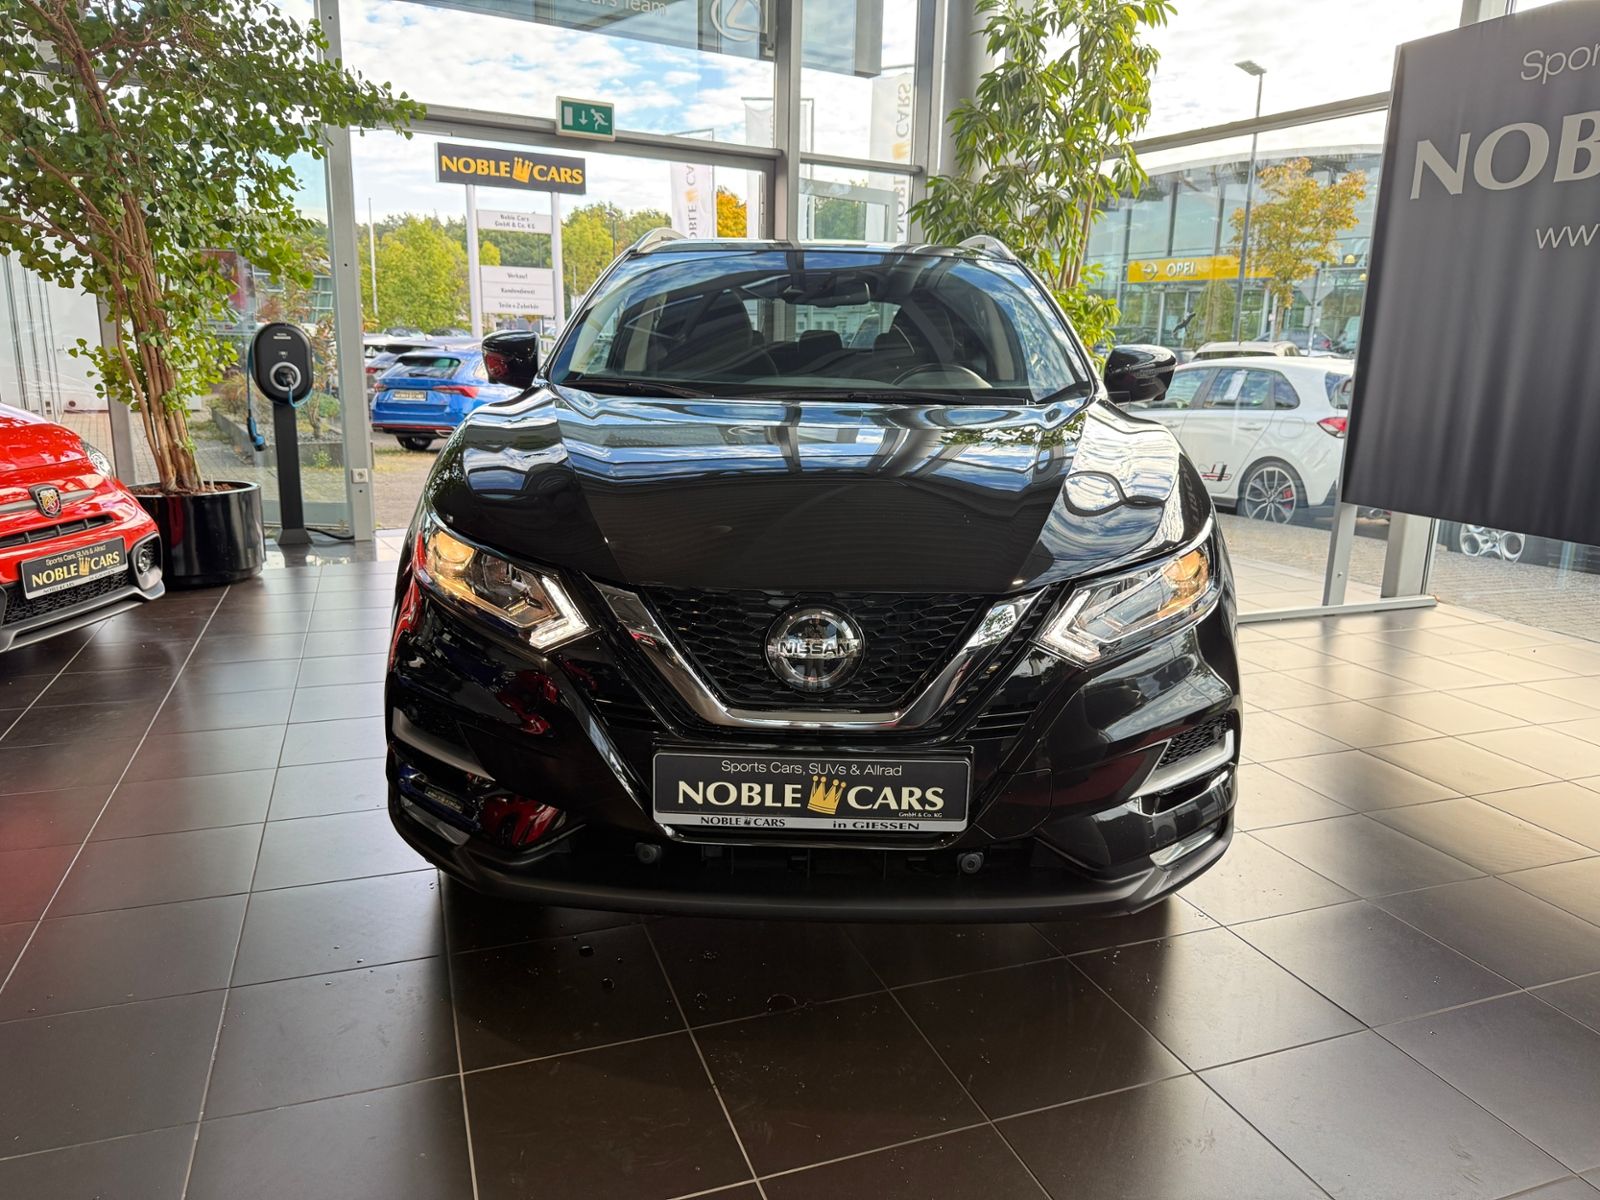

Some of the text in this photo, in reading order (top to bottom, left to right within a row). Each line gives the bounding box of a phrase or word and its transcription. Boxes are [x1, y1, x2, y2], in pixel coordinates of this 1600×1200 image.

[441, 155, 584, 185] NOBLE CARS
[1536, 223, 1600, 249] ww
[1166, 261, 1198, 277] OPEL
[31, 551, 120, 588] NOBLE CARS
[779, 641, 850, 655] NISSAN
[721, 760, 903, 776] Sports Cars, SUVs & Allrad
[677, 780, 945, 811] NOBLE CARS
[700, 815, 920, 831] NOBLE CARS in GIESSEN
